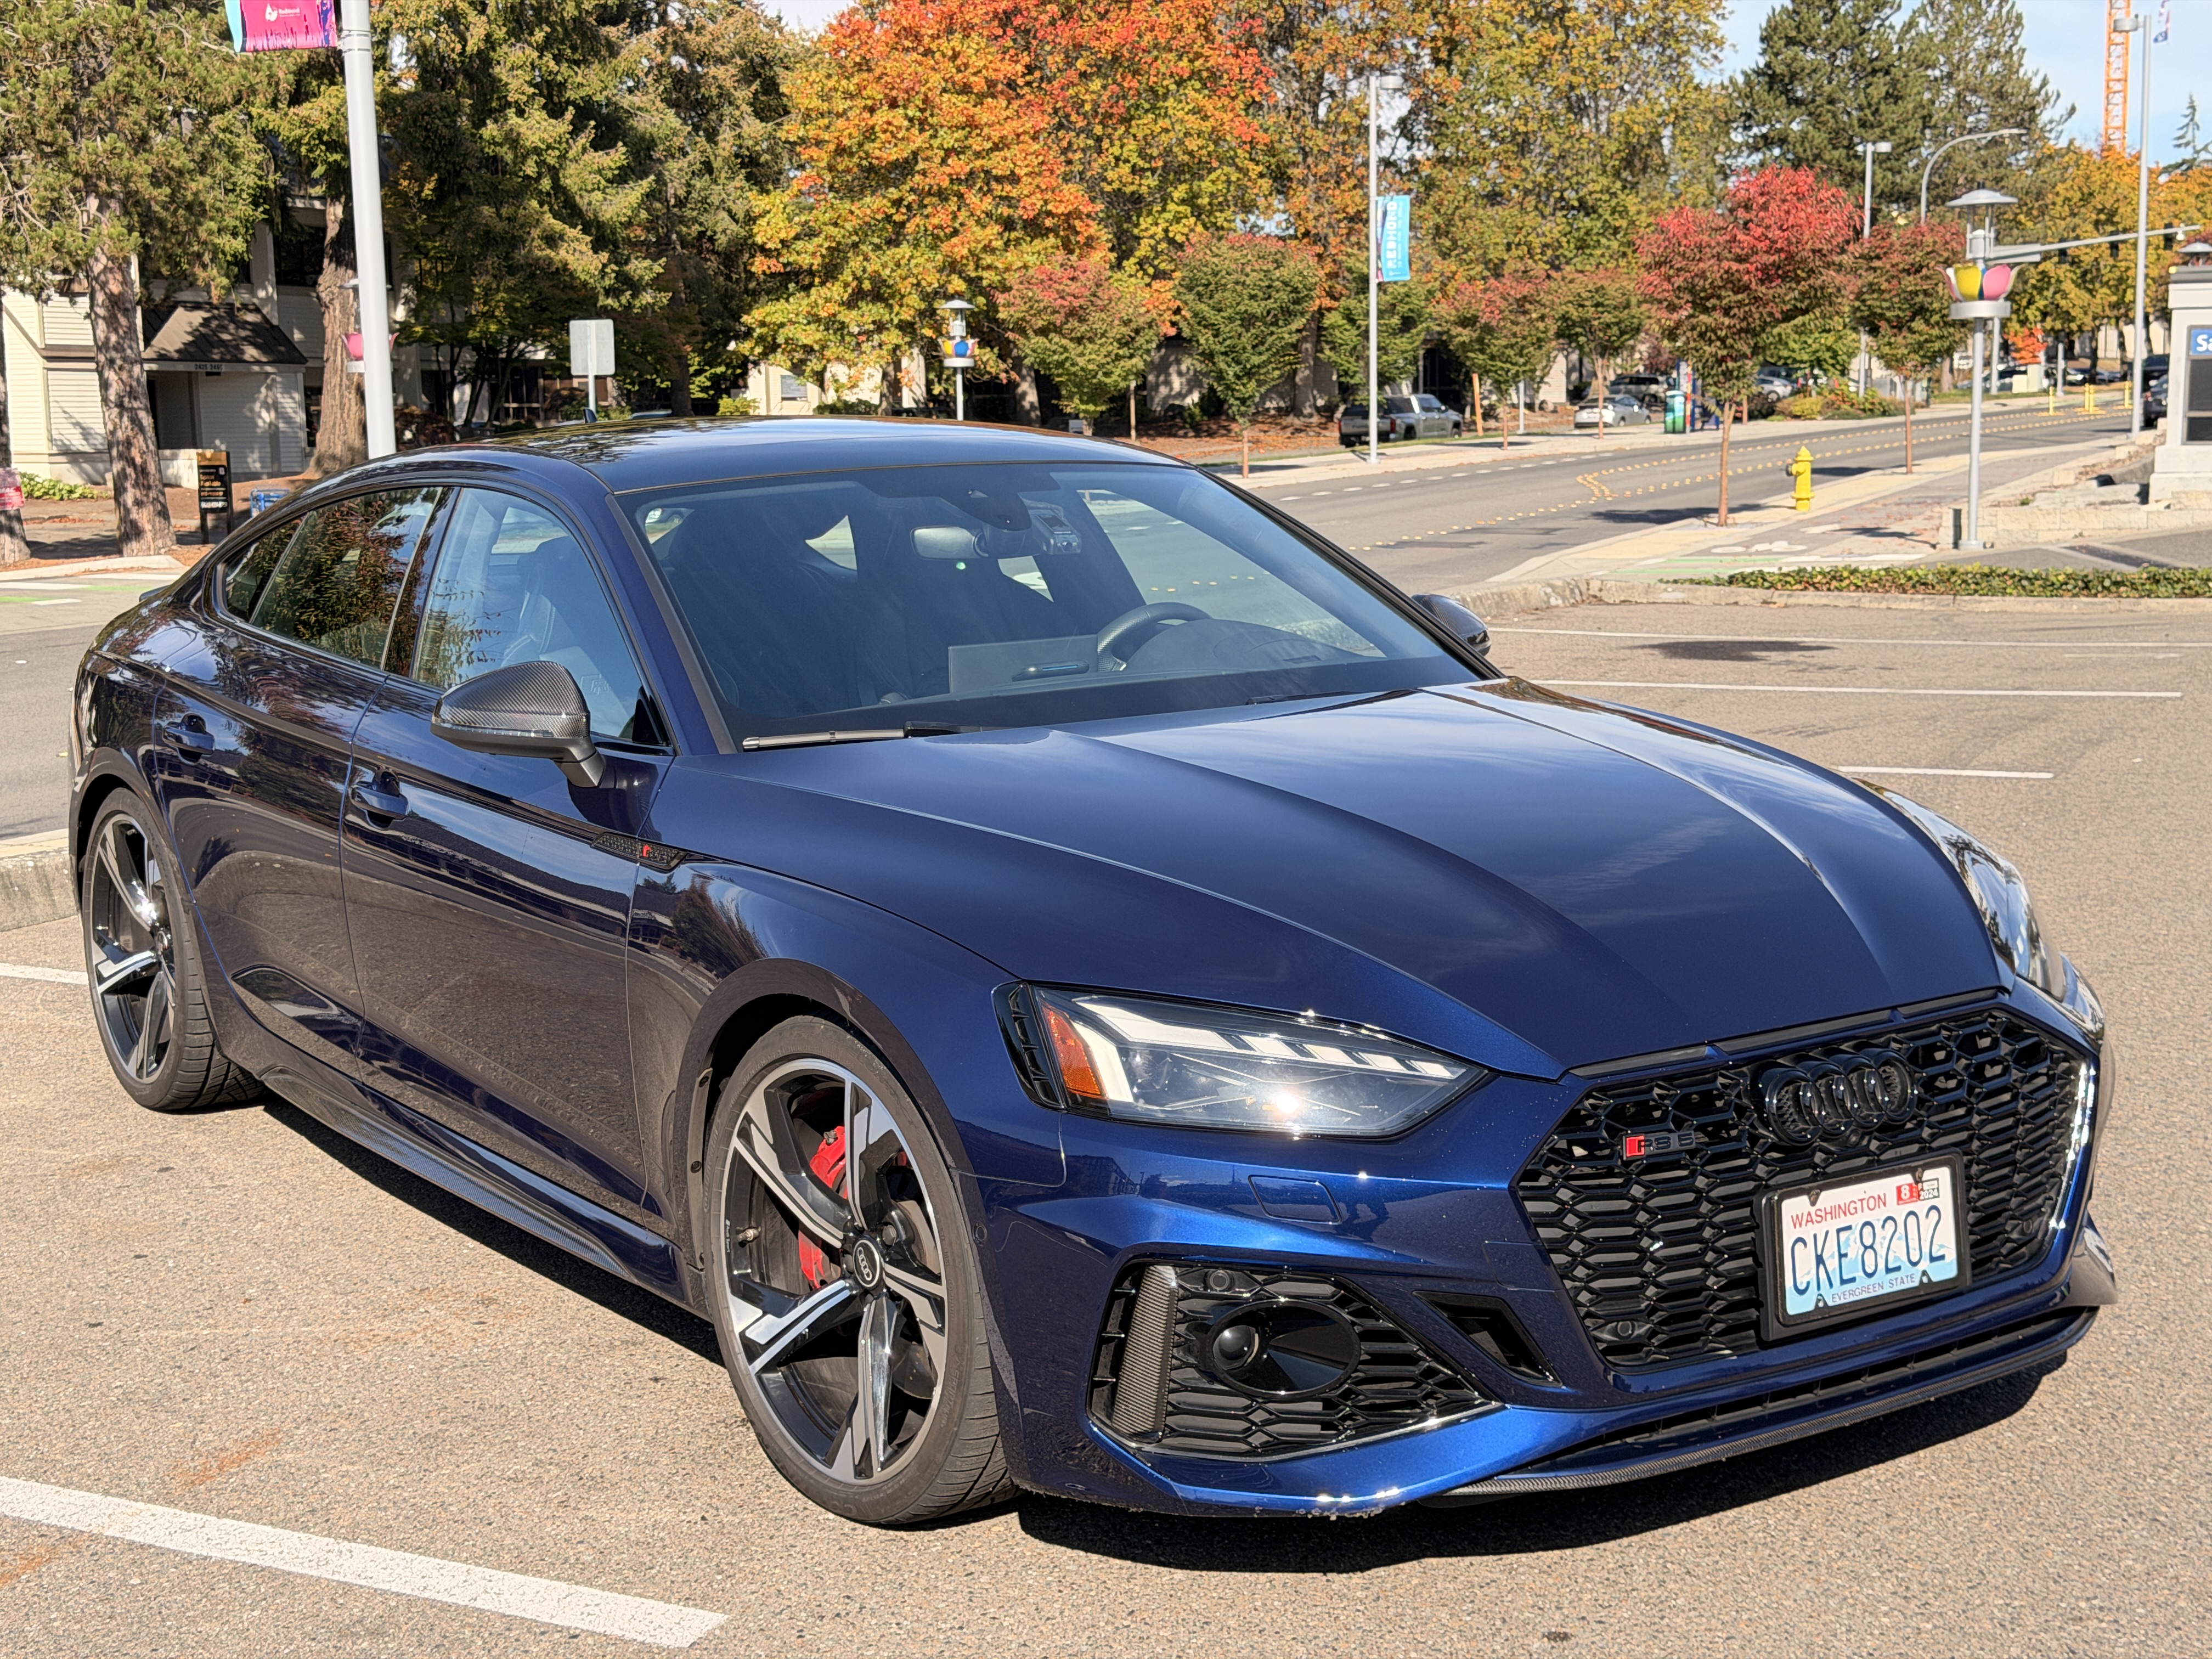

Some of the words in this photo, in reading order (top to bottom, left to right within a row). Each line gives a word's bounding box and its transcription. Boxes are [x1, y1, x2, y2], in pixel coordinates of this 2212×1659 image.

[1386, 201, 1397, 269] REDMOND
[1900, 1184, 1910, 1200] 8
[1919, 1188, 1938, 1200] 2024
[1791, 1192, 1887, 1229] WASHINGTON
[1791, 1205, 1946, 1296] CKE8202
[1831, 1281, 1884, 1303] EVERGREEN
[1888, 1273, 1916, 1289] STATE
